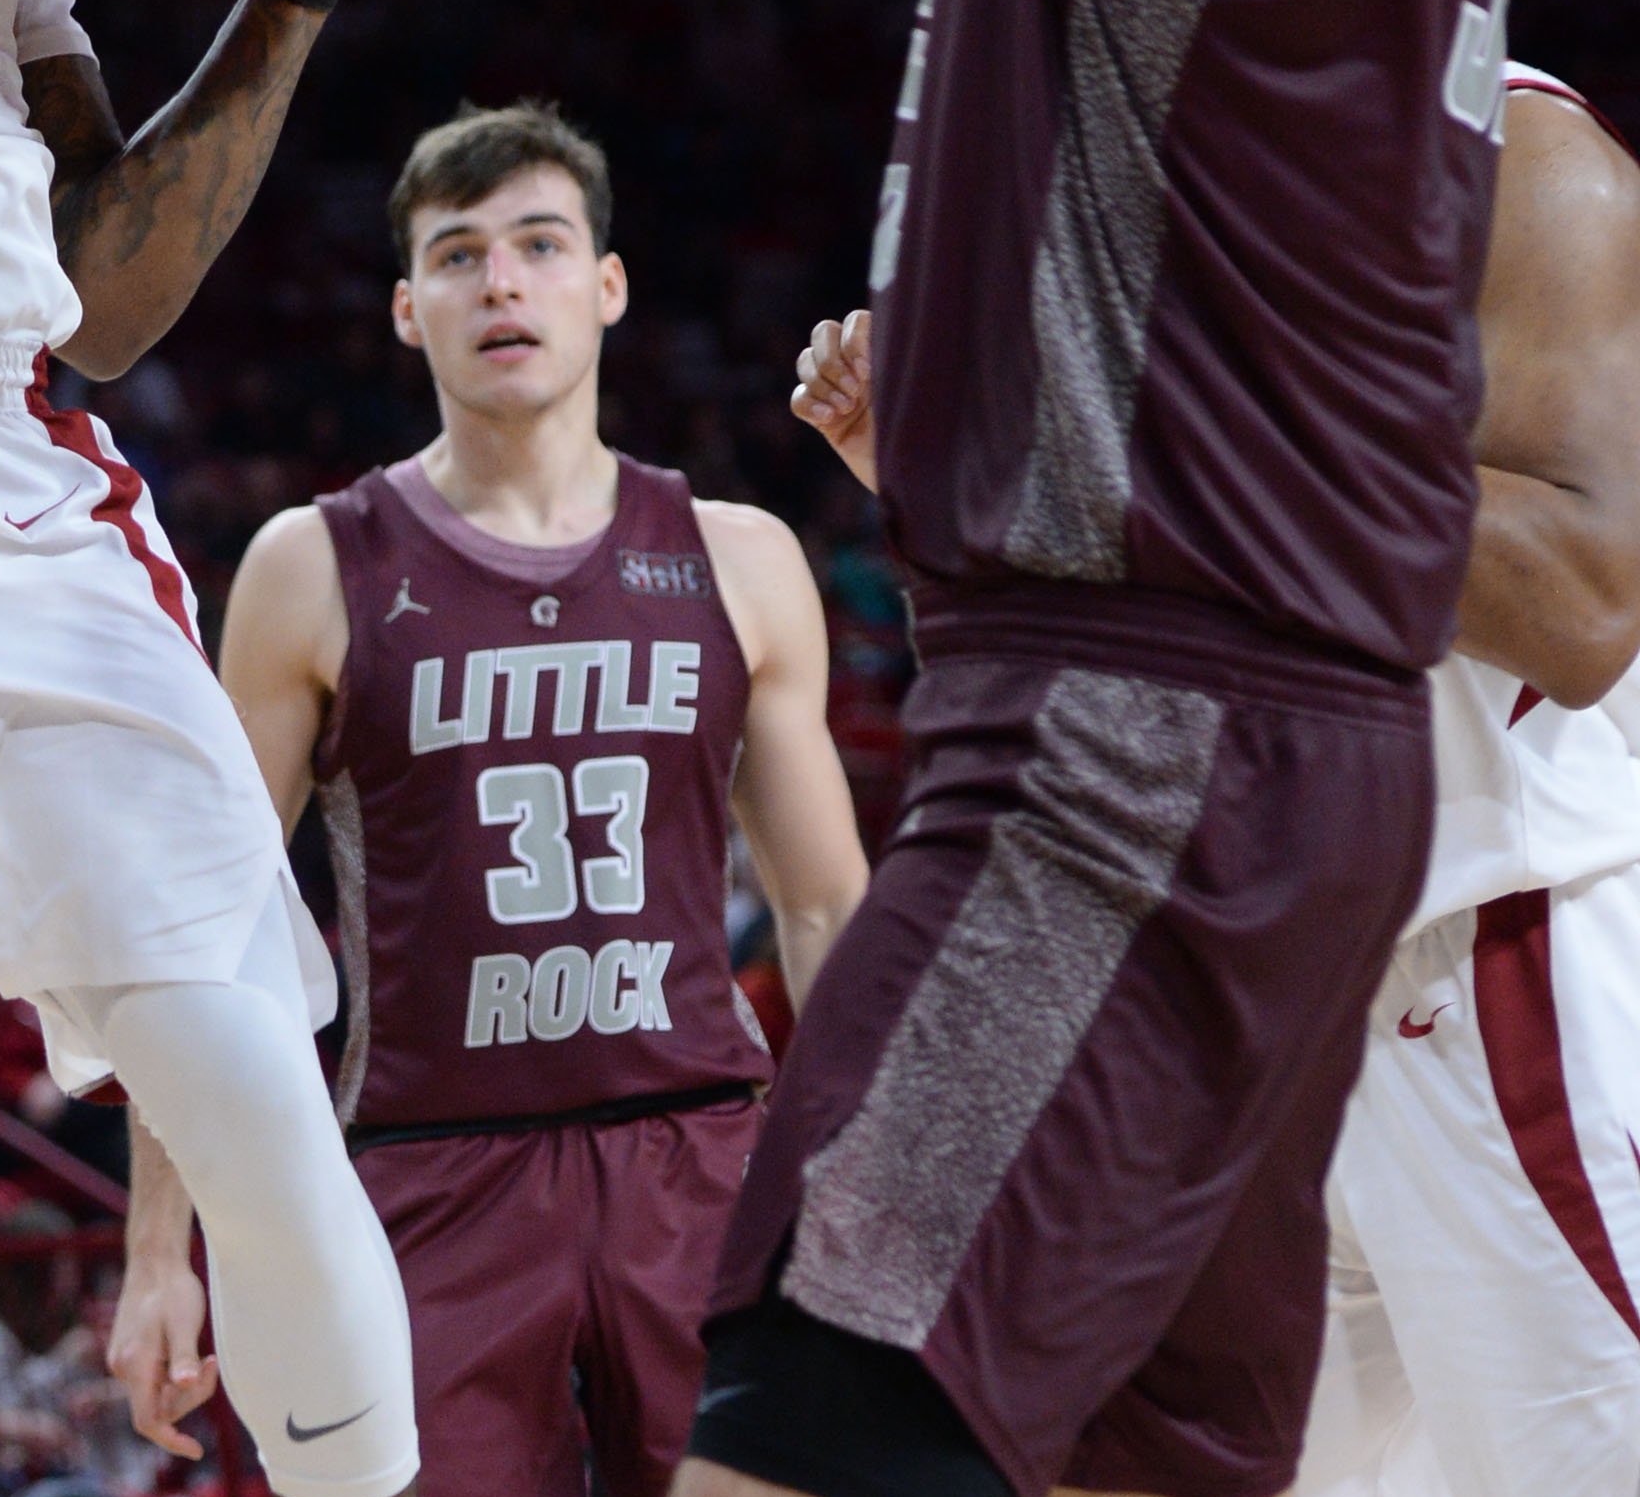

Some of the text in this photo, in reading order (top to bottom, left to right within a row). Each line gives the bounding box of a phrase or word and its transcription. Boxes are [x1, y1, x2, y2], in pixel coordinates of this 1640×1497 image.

[410, 639, 701, 755] LITTLE
[477, 755, 650, 926] 33
[464, 938, 675, 1049] ROCK
